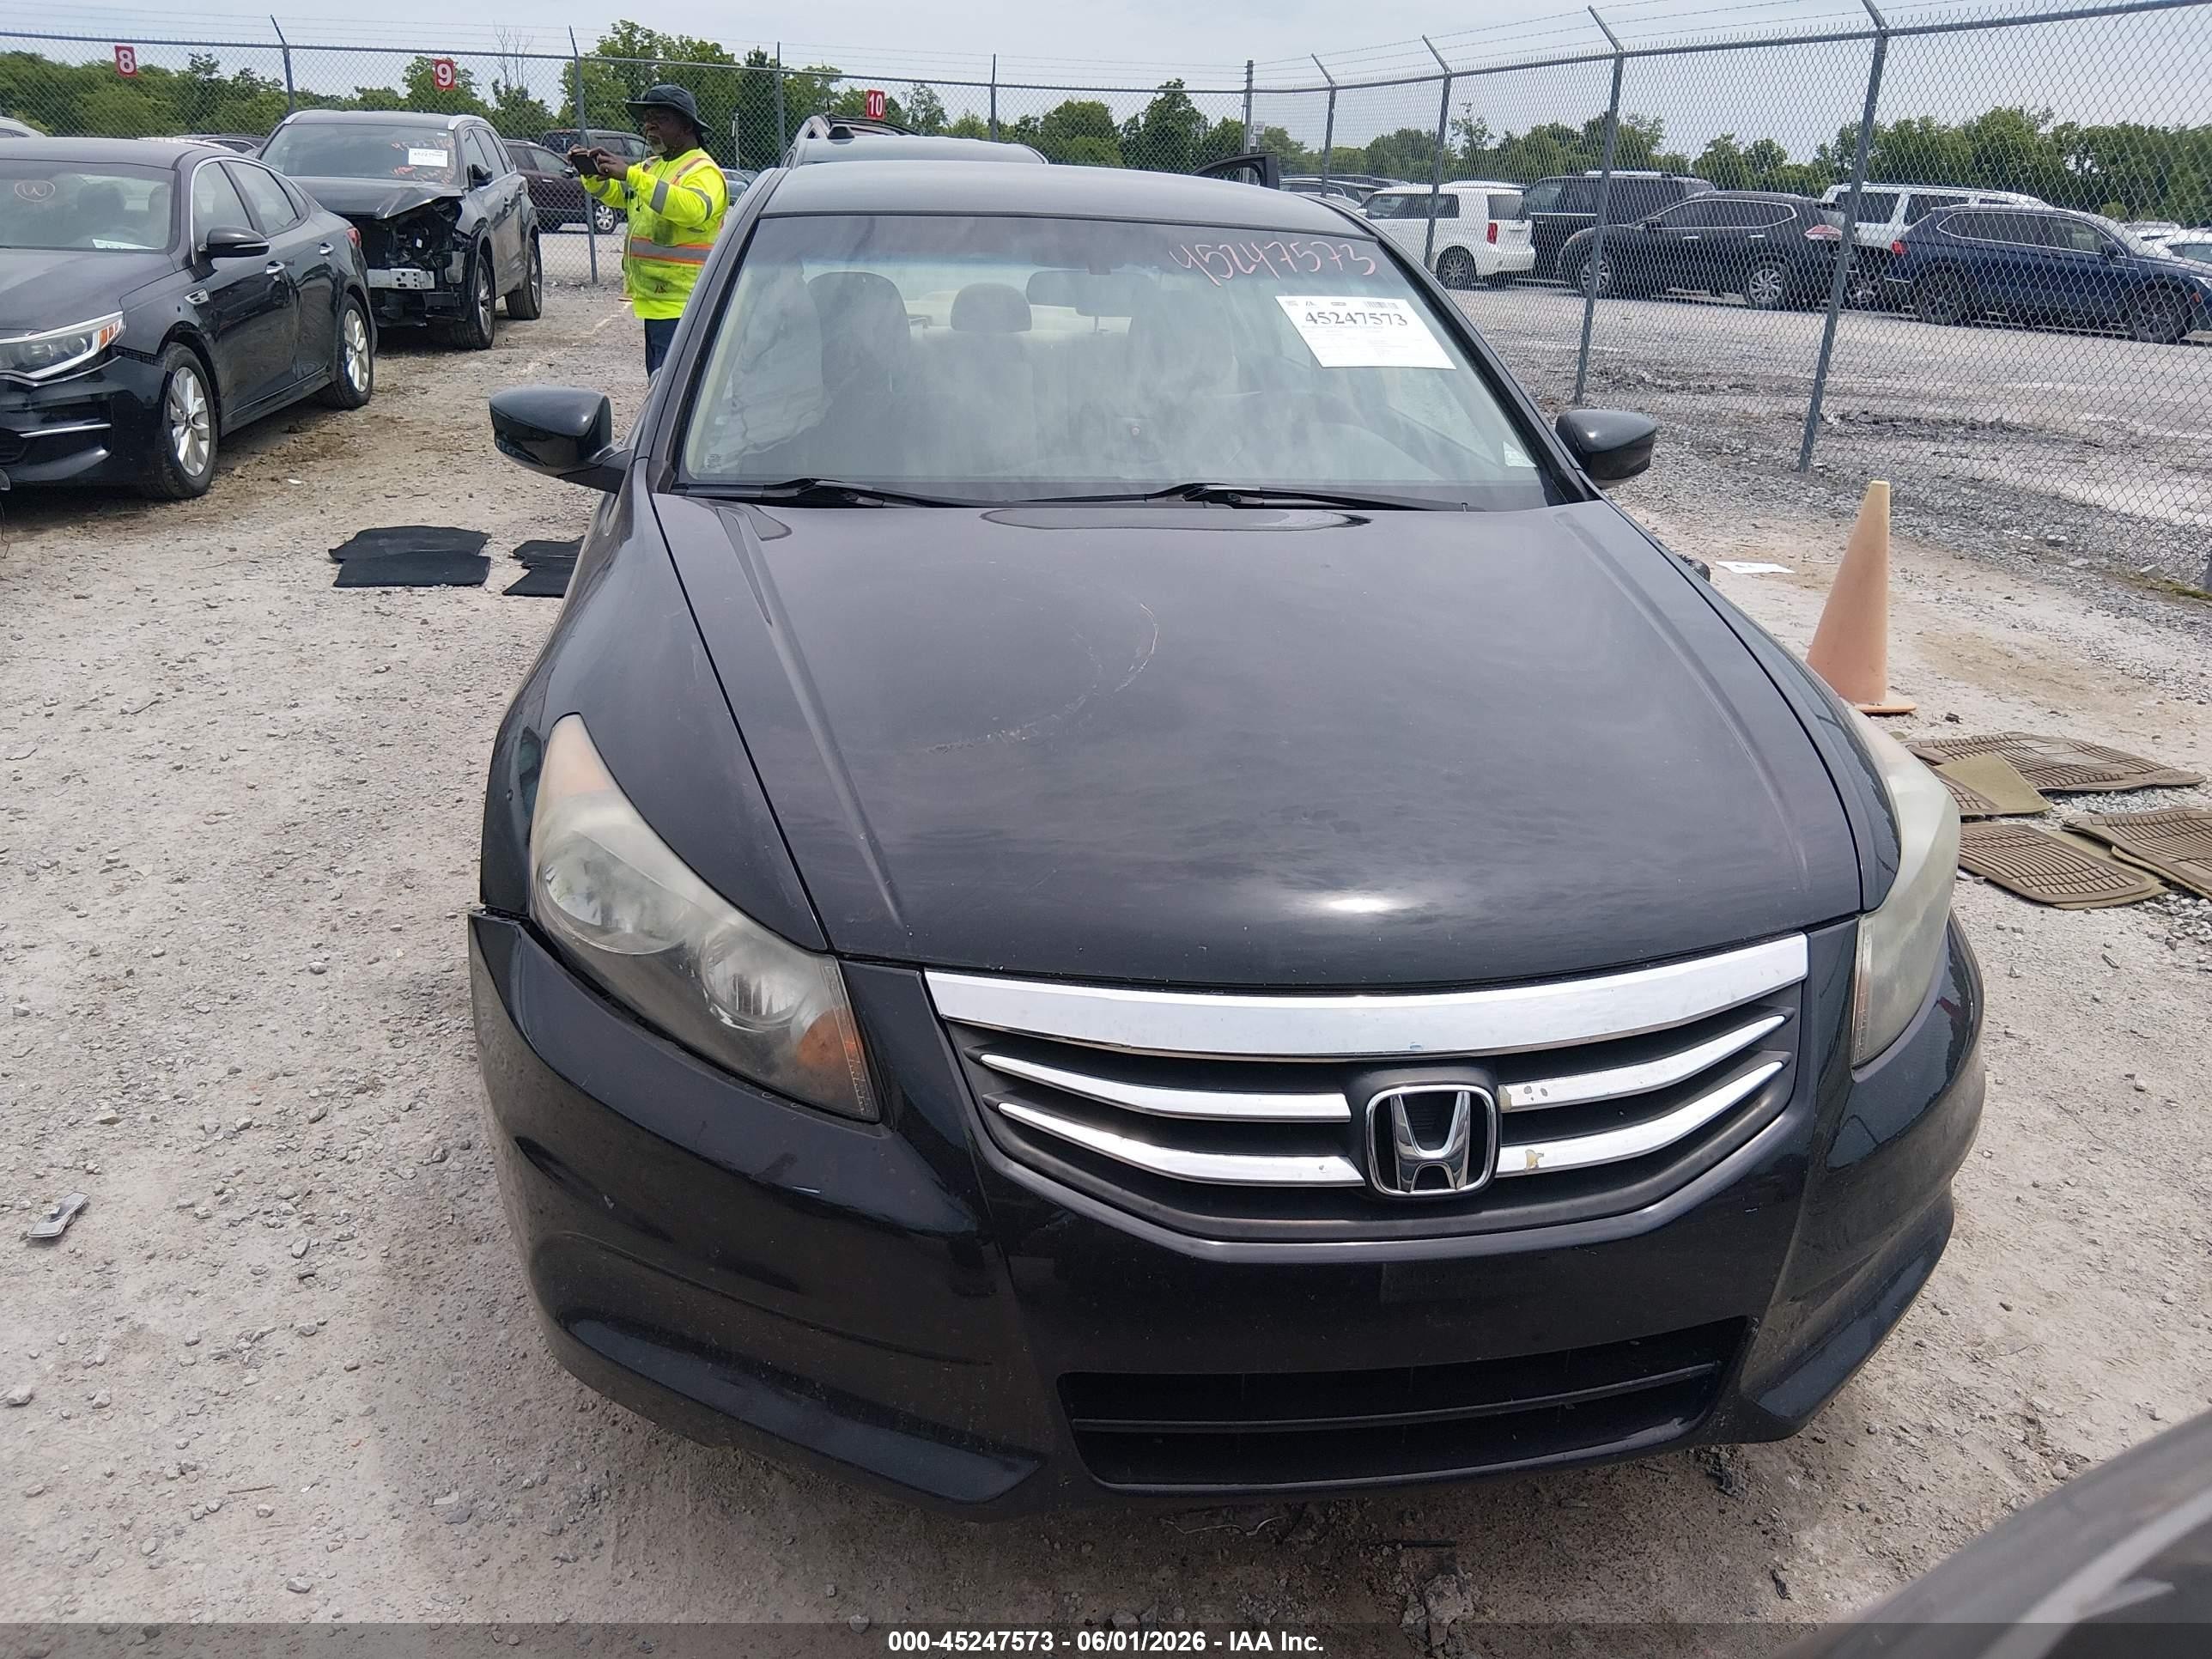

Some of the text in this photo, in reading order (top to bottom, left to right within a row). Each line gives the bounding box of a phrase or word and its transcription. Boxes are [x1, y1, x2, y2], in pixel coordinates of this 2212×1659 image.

[118, 50, 135, 73] 8
[437, 64, 453, 86] 9
[868, 94, 884, 116] 10
[1169, 240, 1376, 287] 45247573
[1304, 311, 1408, 326] 45247573
